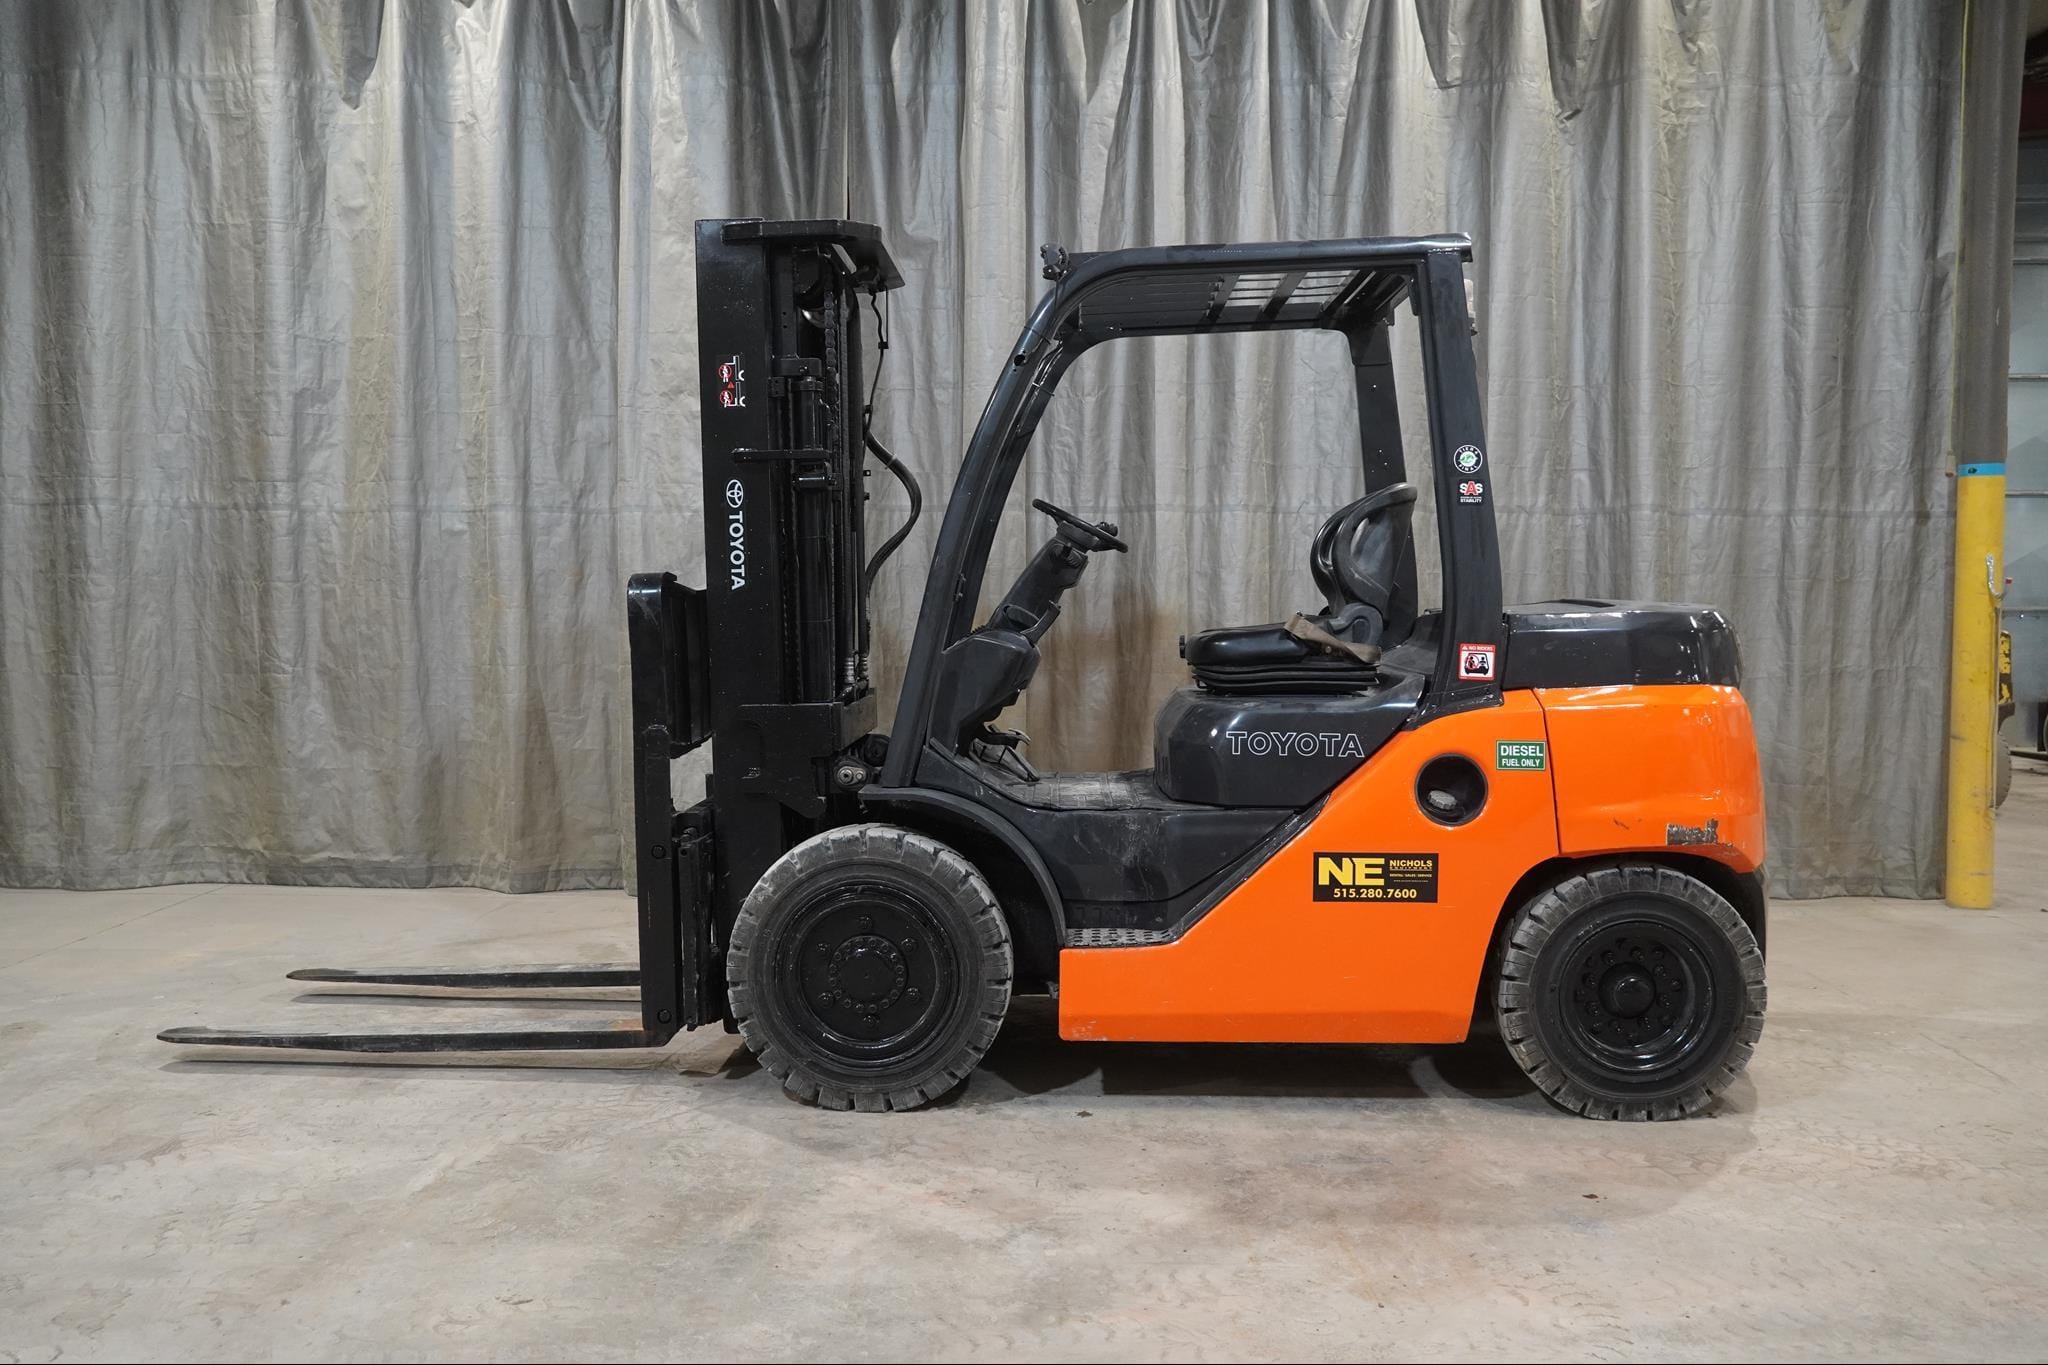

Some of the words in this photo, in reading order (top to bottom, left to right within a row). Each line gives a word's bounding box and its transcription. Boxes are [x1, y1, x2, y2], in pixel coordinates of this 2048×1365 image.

[1459, 481, 1483, 495] SAS
[729, 511, 746, 590] TOYOTA
[1225, 731, 1365, 758] TOYOTA
[1500, 744, 1544, 757] DIESEL
[1501, 758, 1521, 767] FUEL
[1521, 759, 1541, 768] ONLY
[1389, 859, 1433, 867] NICHOLS
[1318, 857, 1385, 886] NE
[1333, 888, 1417, 898] 515.280.7600
